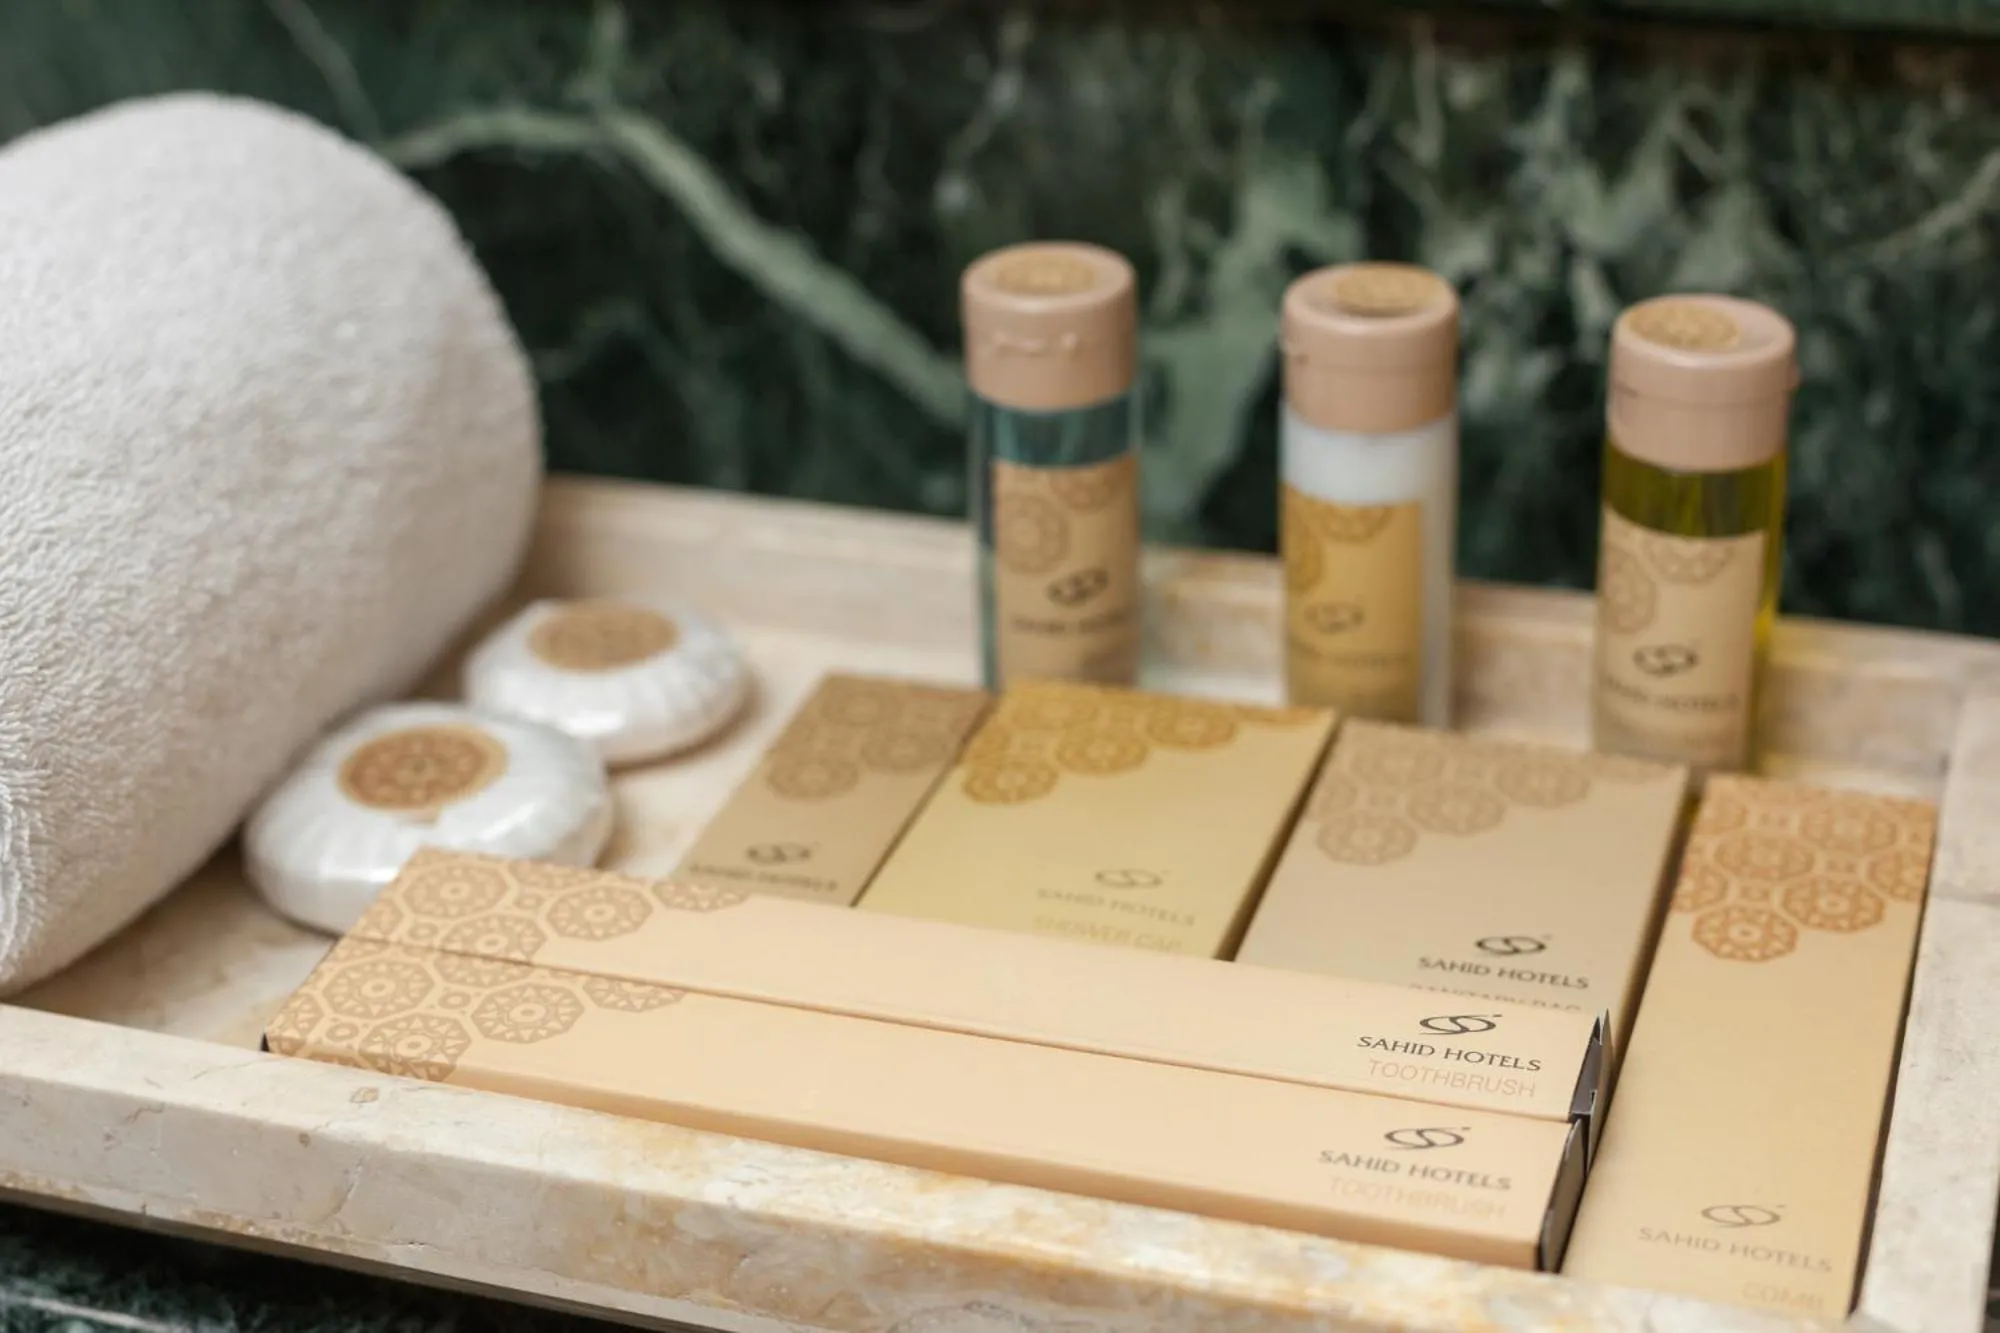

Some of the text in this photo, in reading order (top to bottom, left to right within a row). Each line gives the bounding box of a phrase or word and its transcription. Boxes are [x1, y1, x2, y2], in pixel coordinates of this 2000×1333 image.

[1418, 956, 1590, 990] SAHID HOTELS
[1357, 1036, 1542, 1072] SAHID HOTELS
[1368, 1057, 1537, 1098] TOOTHBRUSH
[1318, 1150, 1512, 1192] SAHID HOTELS
[1330, 1176, 1507, 1219] TOOTHBRUSH
[1638, 1226, 1833, 1273] SAHID HOTELS
